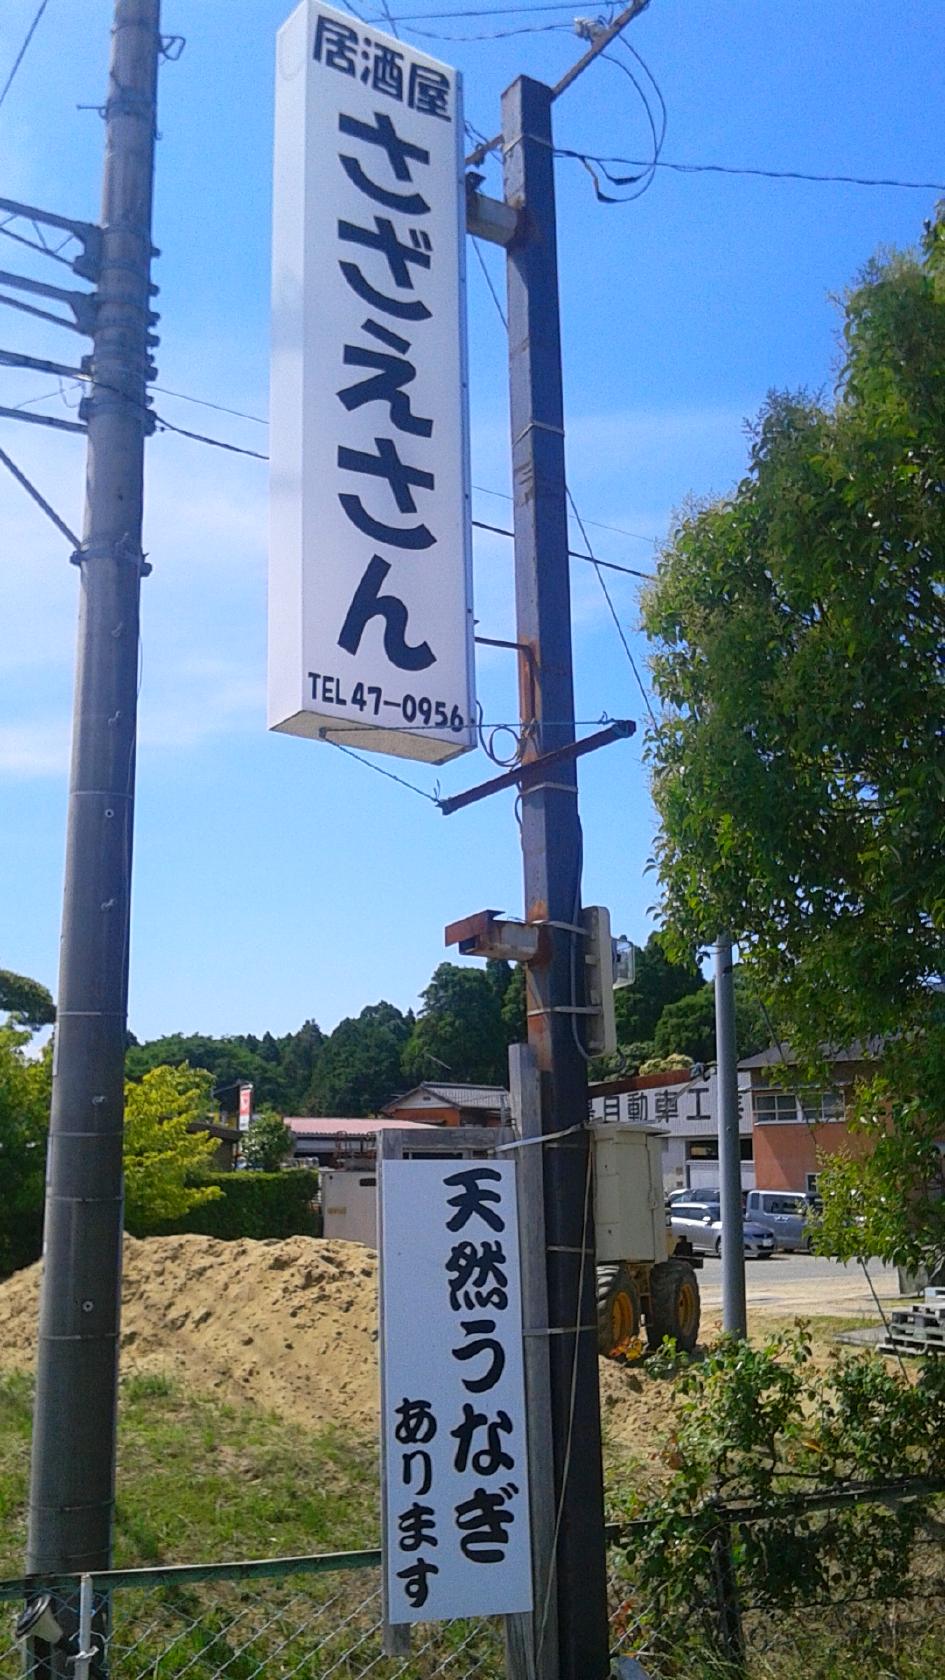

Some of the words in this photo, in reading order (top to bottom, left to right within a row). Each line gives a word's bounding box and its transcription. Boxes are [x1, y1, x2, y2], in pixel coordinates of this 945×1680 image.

[312, 14, 452, 123] 居酒屋
[336, 111, 438, 672] さざえさん
[308, 671, 347, 706] TEL
[350, 681, 465, 733] 47-0956
[586, 1088, 745, 1123] 自動車工
[443, 1167, 519, 1564] 天然うなぎ
[394, 1396, 440, 1609] あります
